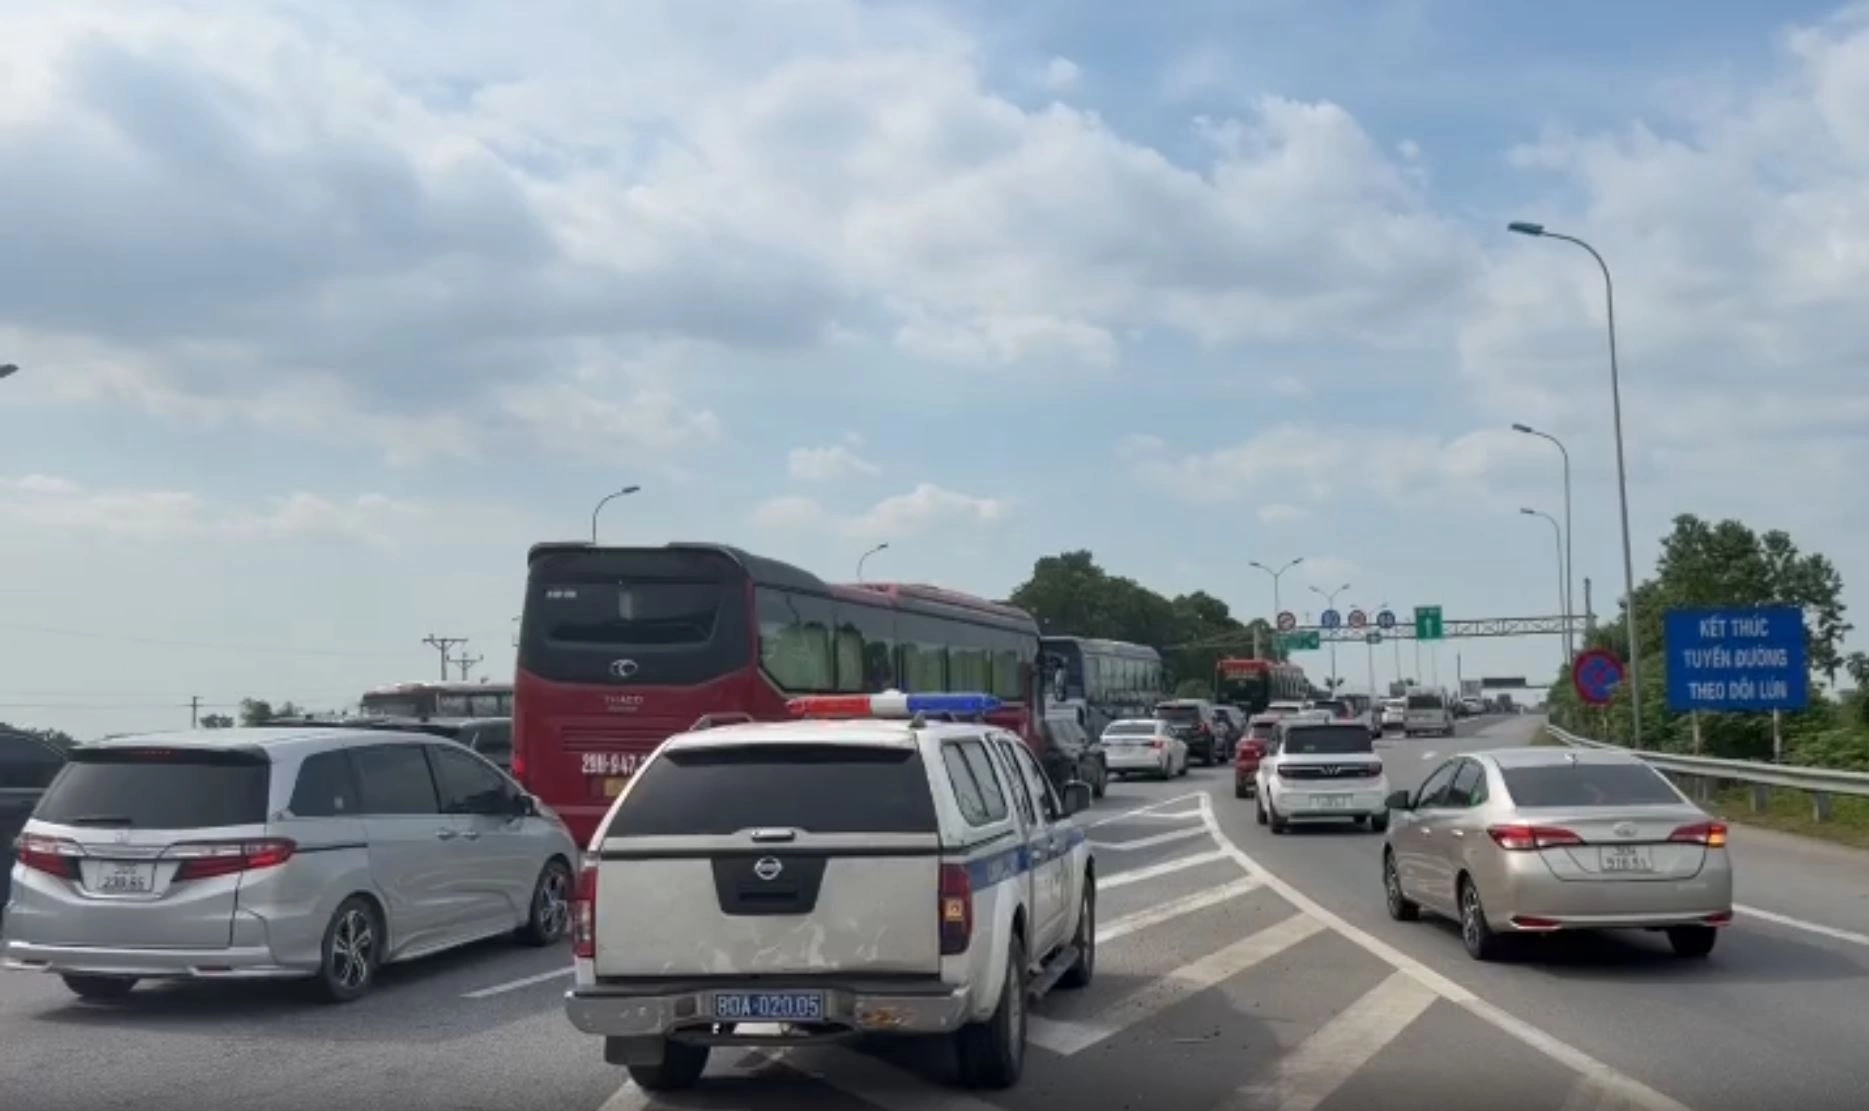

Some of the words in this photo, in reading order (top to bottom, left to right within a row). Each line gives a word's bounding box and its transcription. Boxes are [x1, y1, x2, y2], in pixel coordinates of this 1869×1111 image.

[1700, 613, 1727, 637] KẾT
[1730, 613, 1769, 637] THÚC
[1688, 681, 1725, 700] THEO
